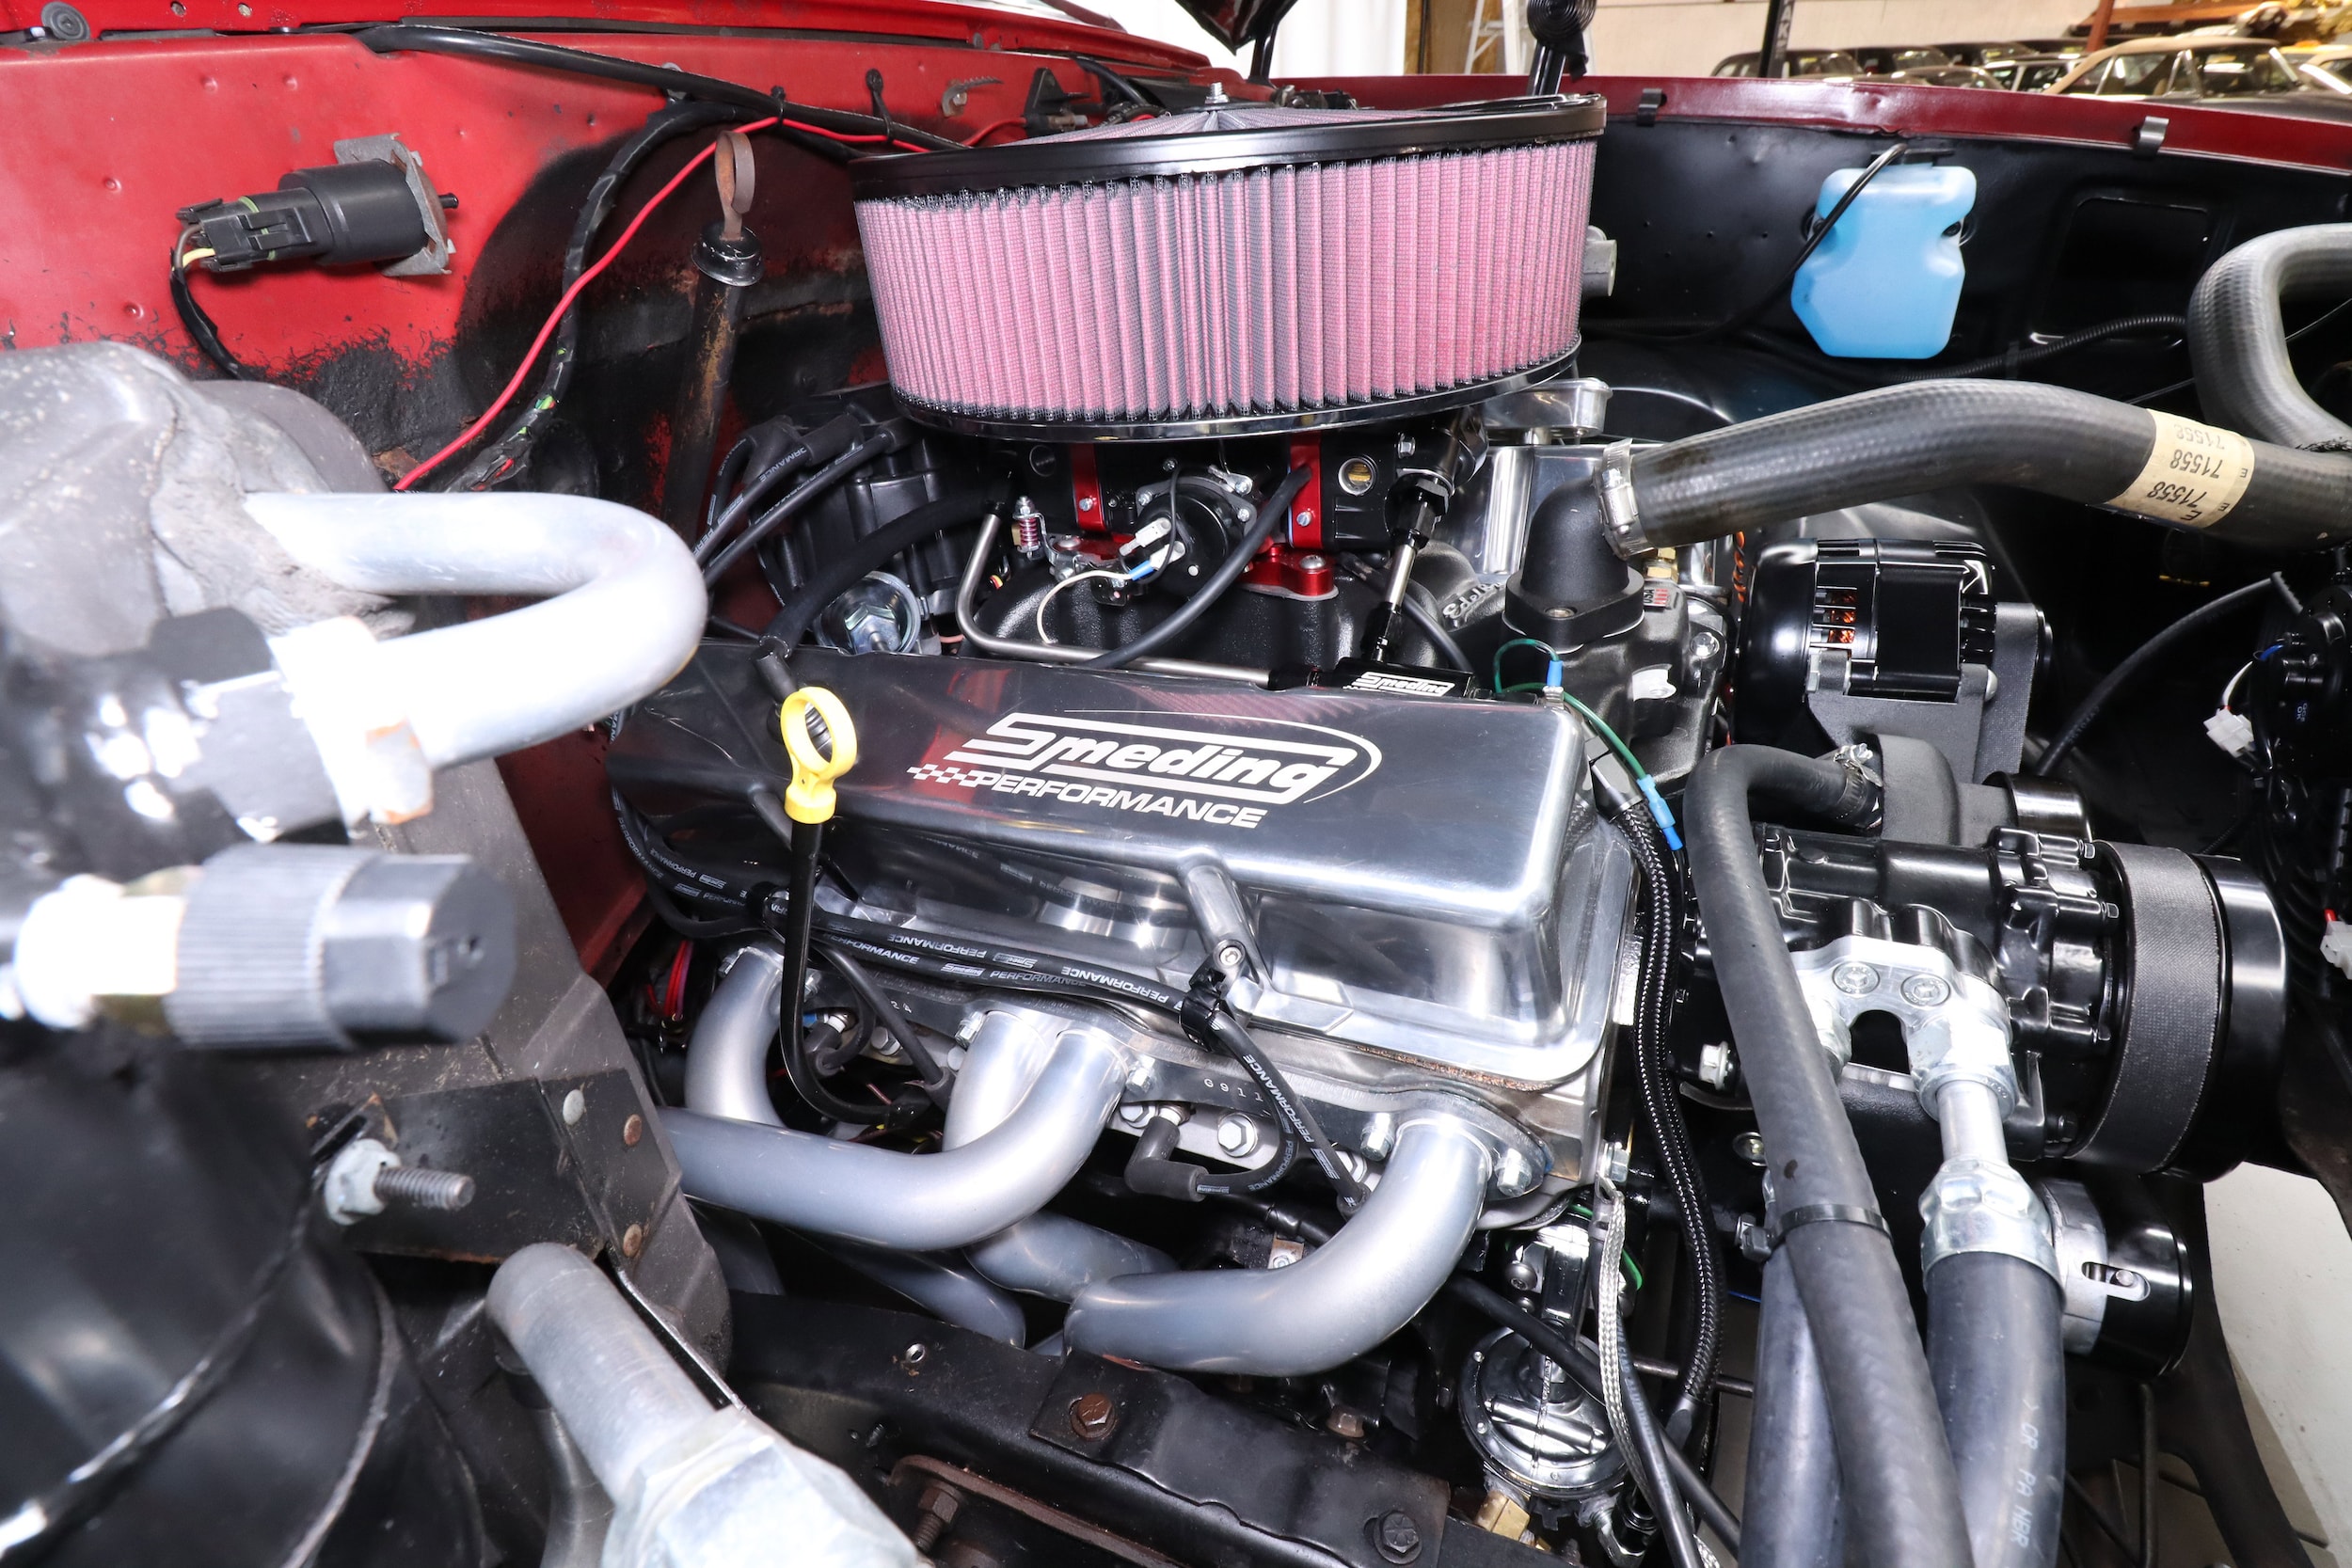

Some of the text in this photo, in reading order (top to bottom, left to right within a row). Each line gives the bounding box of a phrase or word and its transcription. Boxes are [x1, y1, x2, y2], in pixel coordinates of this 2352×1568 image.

[2169, 449, 2224, 479] 71558
[2146, 481, 2207, 509] 71558
[2180, 510, 2203, 521] E
[1350, 671, 1456, 697] Smeding
[943, 711, 1359, 805] Smeding
[972, 773, 1267, 830] PERFORMANCE
[887, 932, 988, 959] PERFORMANCE
[940, 961, 986, 977] Smeding
[1060, 965, 1170, 1005] PERFORMANCE
[1242, 1053, 1315, 1145] PERFORMANCE
[1248, 1138, 1295, 1192] PERFORMANCE
[2020, 1421, 2040, 1450] CR
[2016, 1467, 2037, 1498] PA
[2010, 1504, 2033, 1548] NBR
